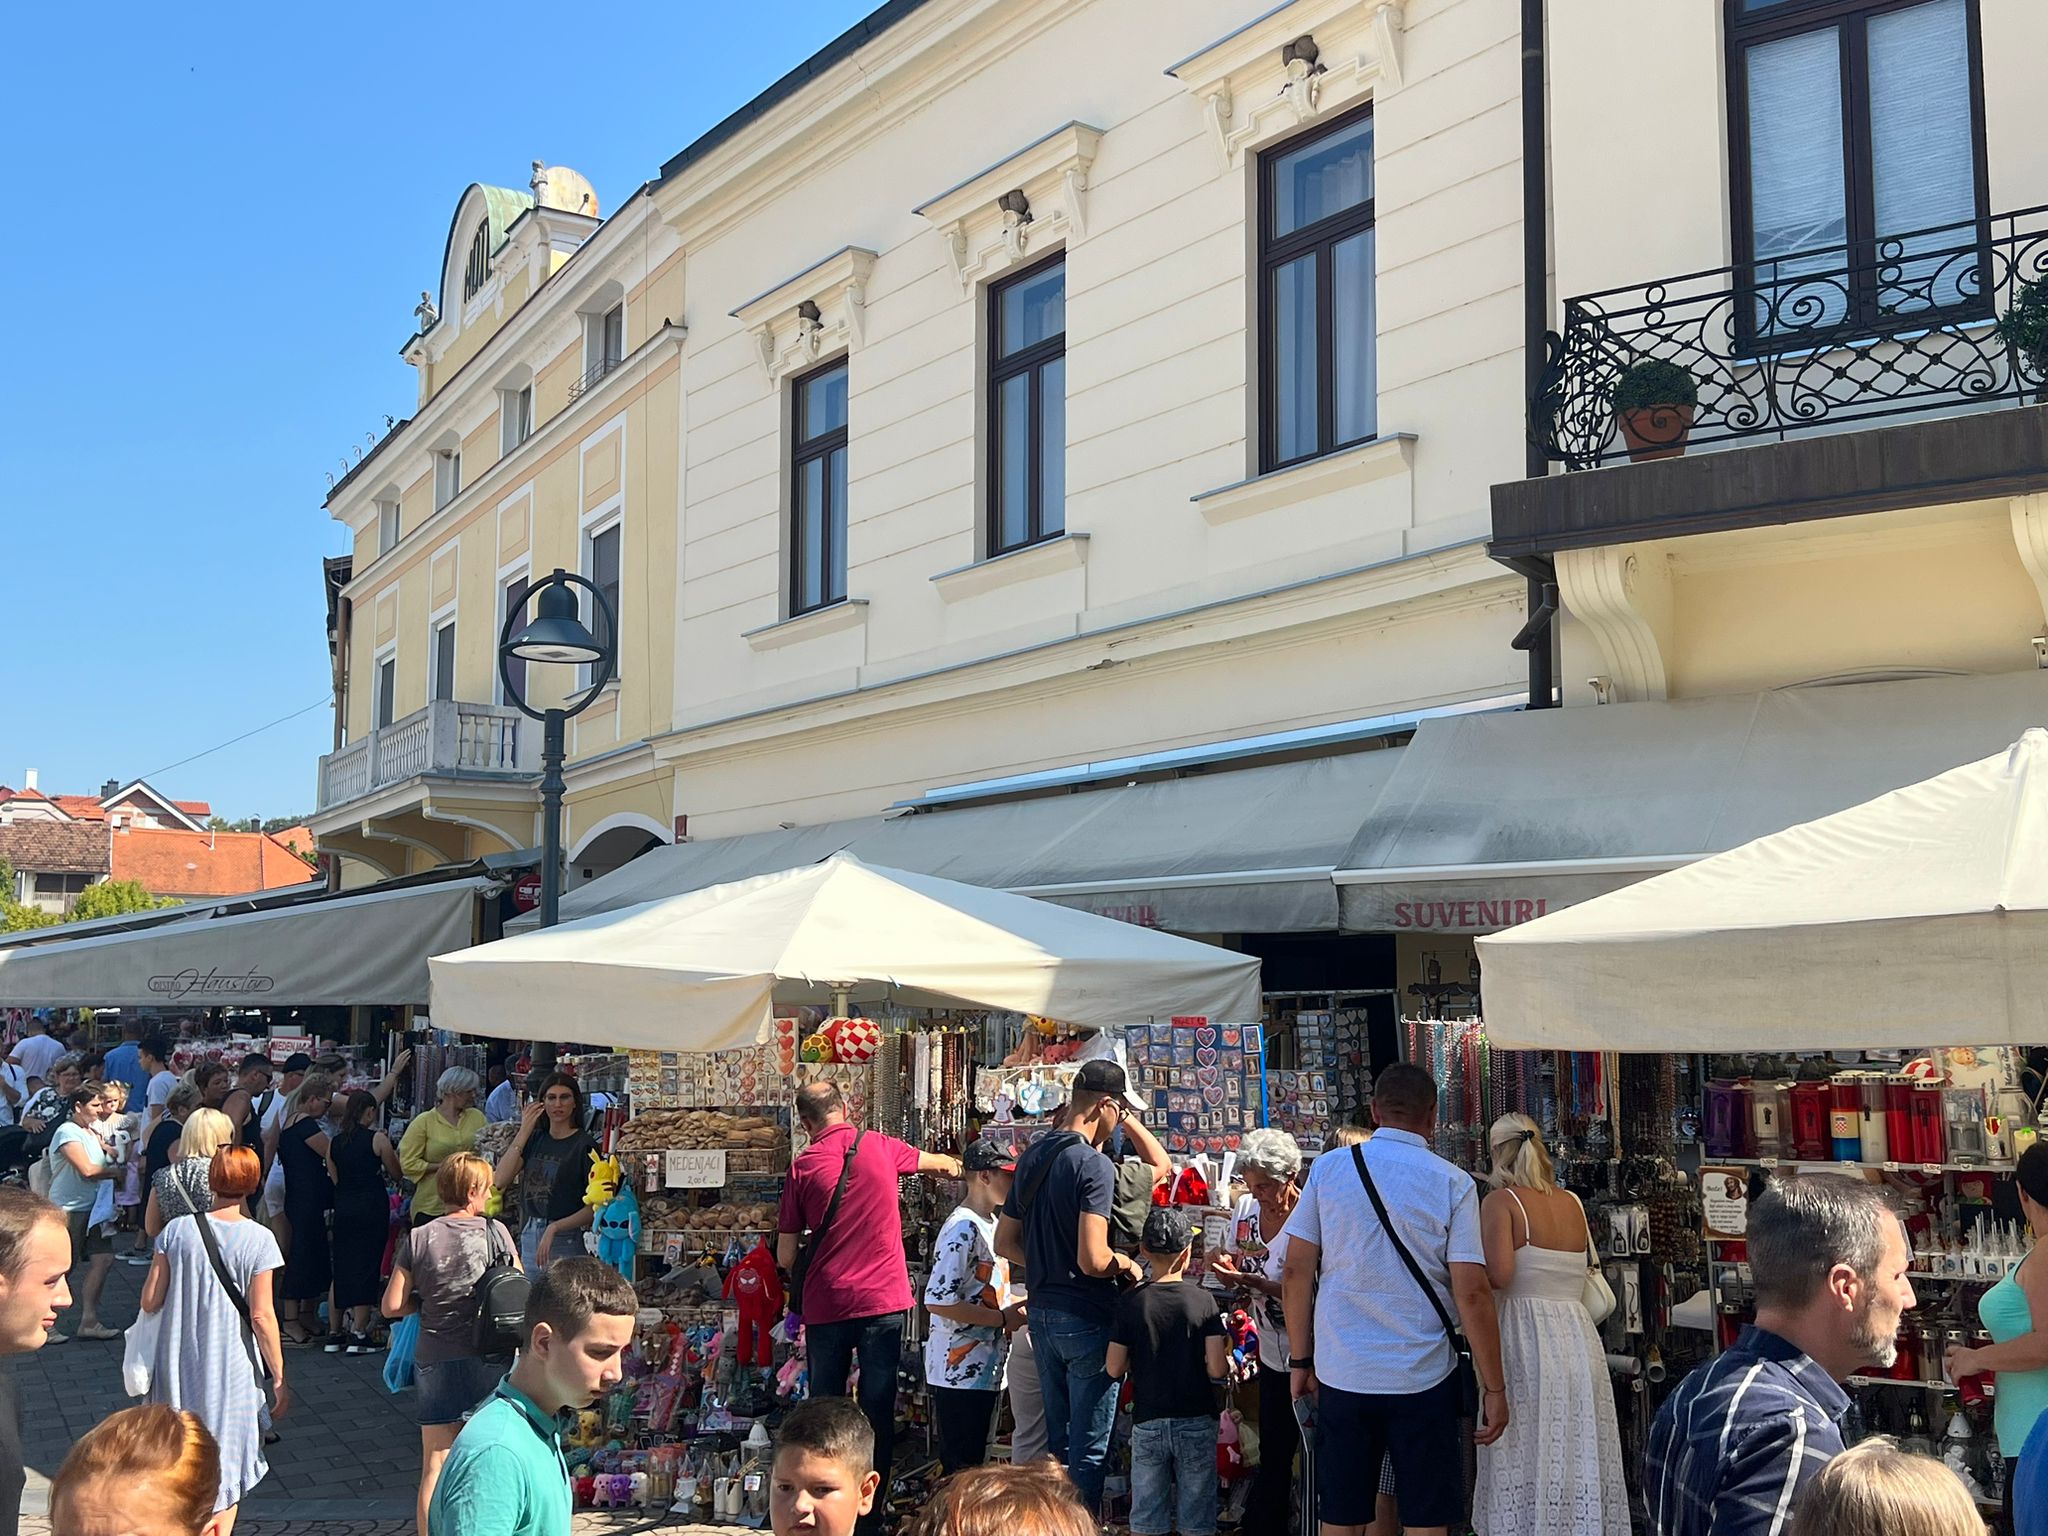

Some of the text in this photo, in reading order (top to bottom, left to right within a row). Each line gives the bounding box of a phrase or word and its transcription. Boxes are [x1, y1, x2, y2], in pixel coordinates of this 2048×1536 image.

[1394, 898, 1547, 928] SUVENIRI
[168, 964, 264, 1000] Haustor
[669, 1155, 720, 1175] MEDENJACI
